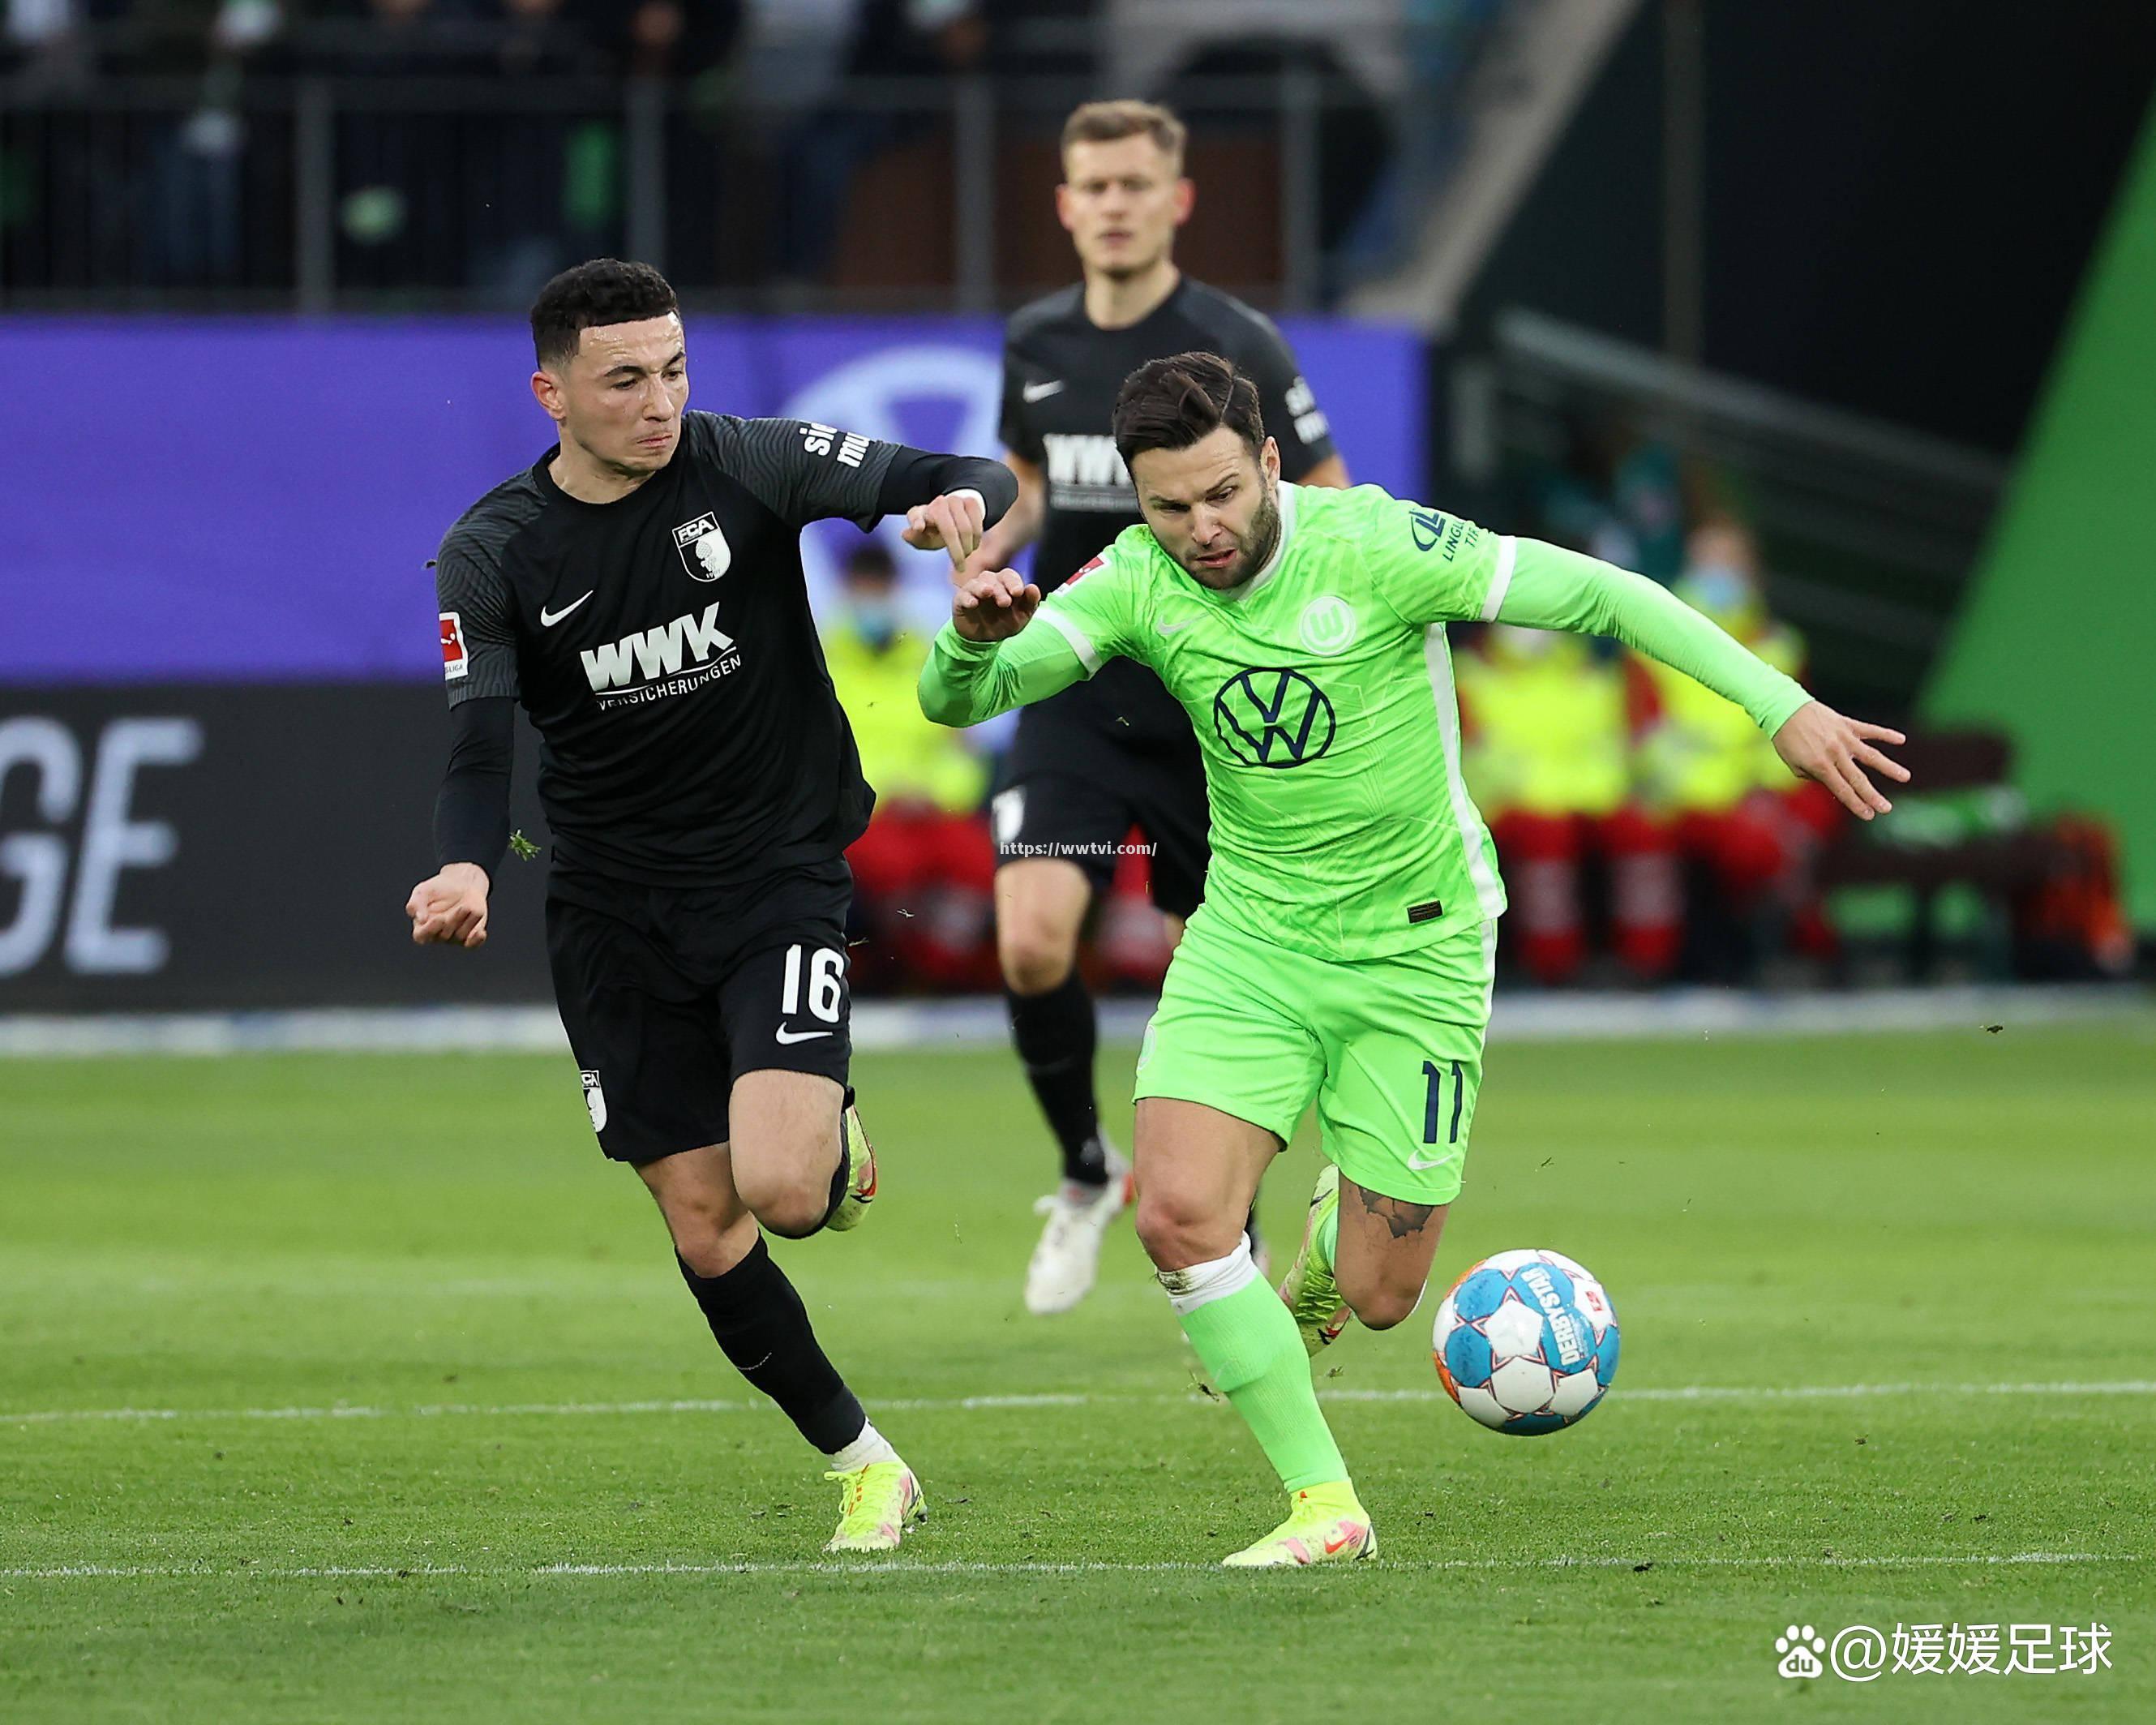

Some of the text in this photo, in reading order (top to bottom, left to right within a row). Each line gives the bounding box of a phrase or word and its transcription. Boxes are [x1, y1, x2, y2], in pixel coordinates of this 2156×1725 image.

[678, 519, 714, 543] FCA
[580, 601, 734, 692] WWK
[1214, 667, 1336, 769] VW
[0, 715, 206, 976] GE
[782, 944, 845, 1023] 16
[1421, 1059, 1464, 1144] 11
[1520, 1267, 1581, 1366] DERBYSTAR
